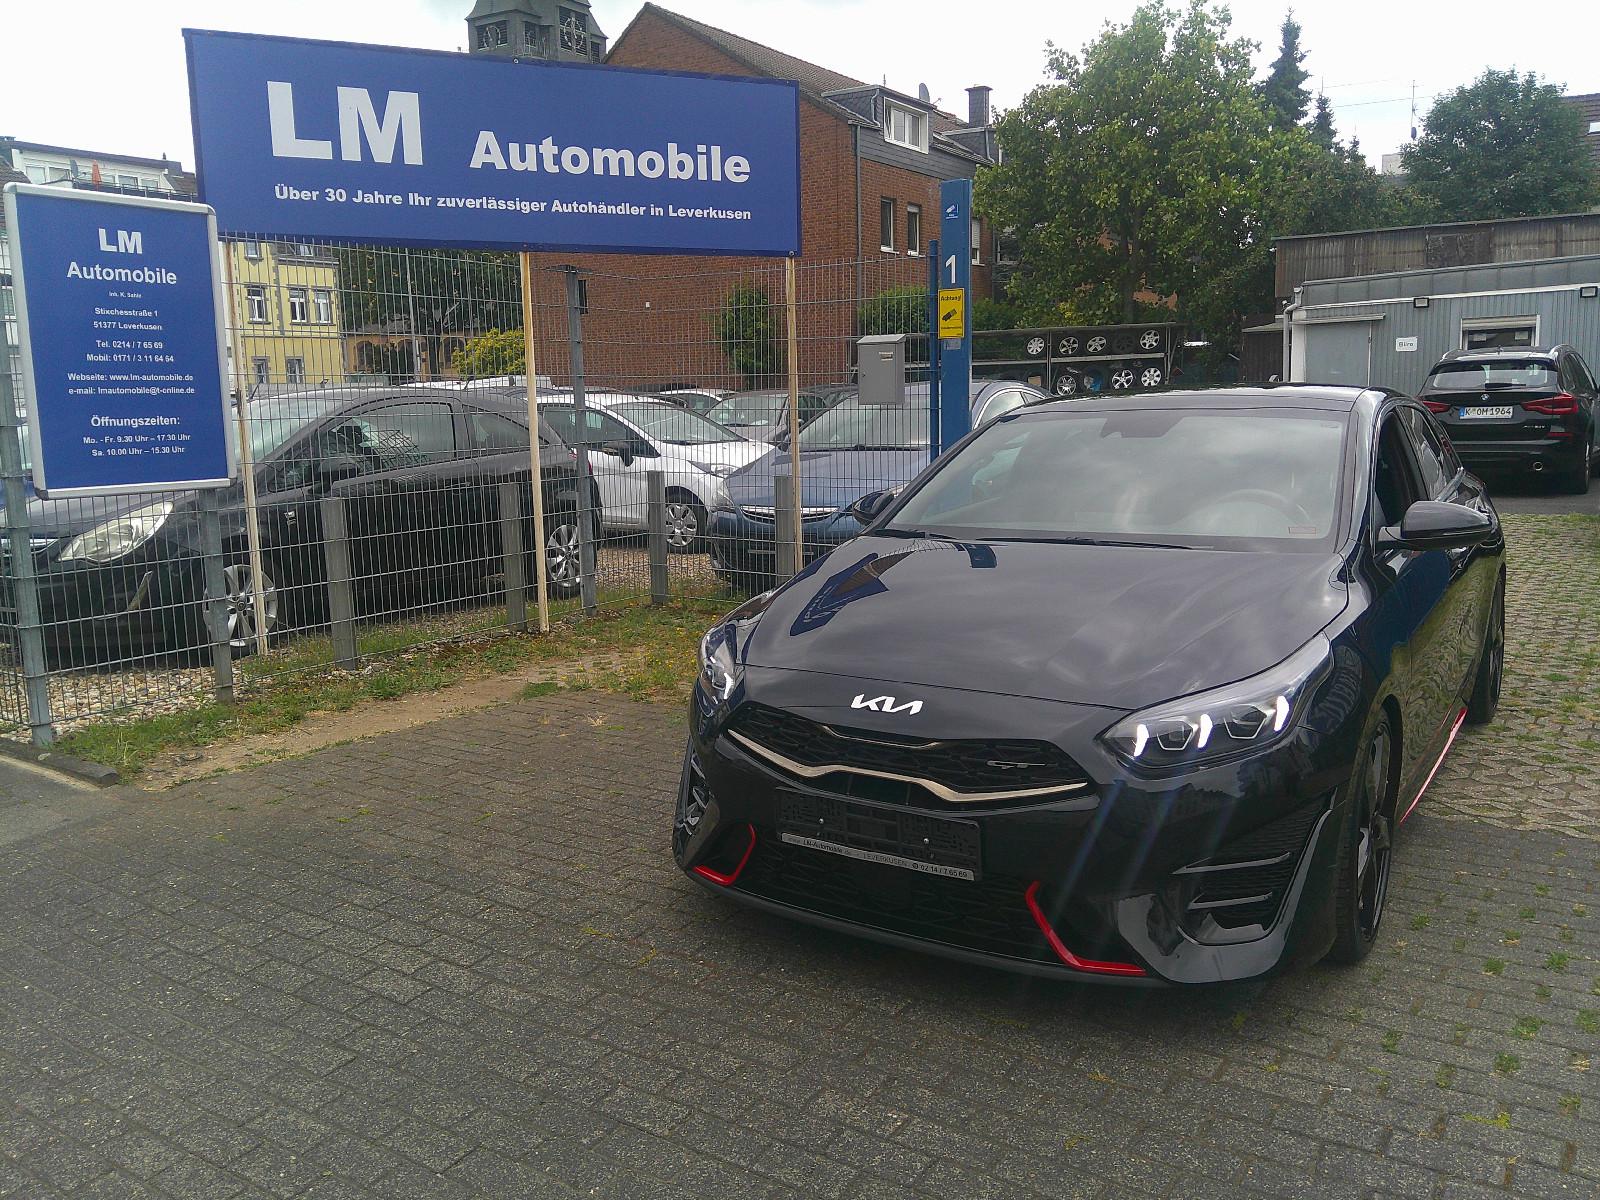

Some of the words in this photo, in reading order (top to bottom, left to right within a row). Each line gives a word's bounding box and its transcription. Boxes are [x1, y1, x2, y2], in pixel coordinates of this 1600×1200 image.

[267, 81, 423, 165] LM
[469, 131, 750, 183] Automobile
[274, 184, 319, 201] Über
[325, 188, 346, 202] 30
[352, 190, 402, 204] Jahre
[408, 193, 432, 206] Ihr
[436, 196, 547, 214] zuverlässiger
[552, 200, 646, 216] Autohändler
[650, 204, 663, 216] in
[668, 204, 751, 220] Leverkusen
[98, 228, 143, 254] LM
[66, 261, 177, 284] Automobile
[945, 255, 956, 284] 1
[94, 307, 152, 317] Stixchesstraße
[93, 321, 117, 329] 51377
[118, 322, 162, 331] Leverkusen
[95, 340, 110, 348] Tel.
[112, 340, 130, 349] 0214
[137, 341, 141, 349] 7
[143, 341, 153, 349] 65
[154, 341, 163, 349] 69
[86, 354, 111, 362] Mobil:
[113, 354, 130, 362] 0171
[67, 373, 108, 381] Webseite:
[109, 373, 193, 381] www.lm-automobile.de
[98, 387, 195, 395] lmautomobile@t-online.de
[91, 415, 180, 428] Öffnungszeiten:
[117, 435, 132, 443] 9.30
[177, 433, 191, 441] Uhr
[91, 449, 105, 457] Sa.
[106, 448, 127, 456] 10.00
[128, 447, 142, 455] Uhr
[151, 446, 170, 454] 15.30
